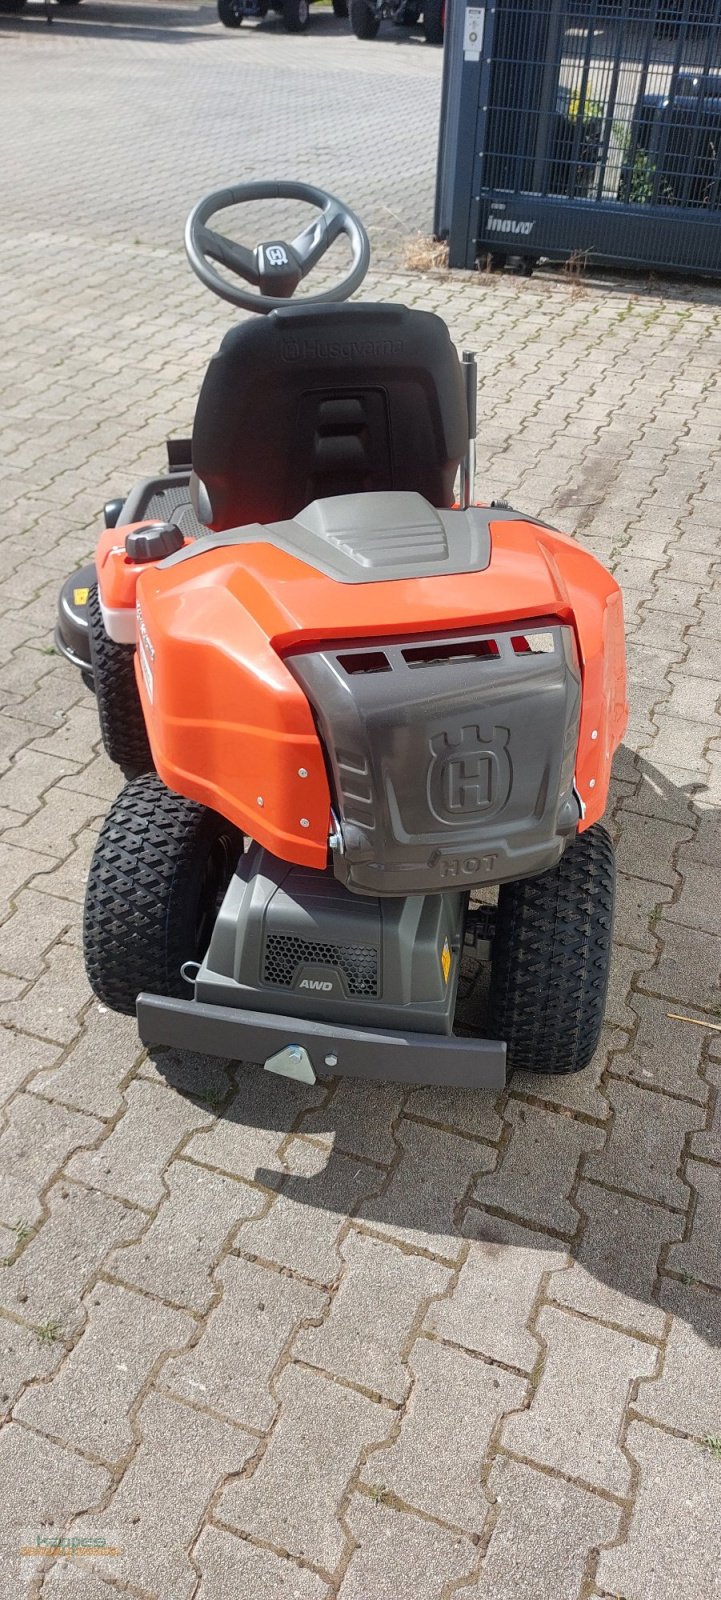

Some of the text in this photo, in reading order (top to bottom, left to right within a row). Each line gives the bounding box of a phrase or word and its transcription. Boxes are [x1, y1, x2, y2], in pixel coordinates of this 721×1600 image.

[303, 338, 405, 360] Husqvarna
[439, 853, 499, 878] HOT
[299, 979, 333, 992] AWD
